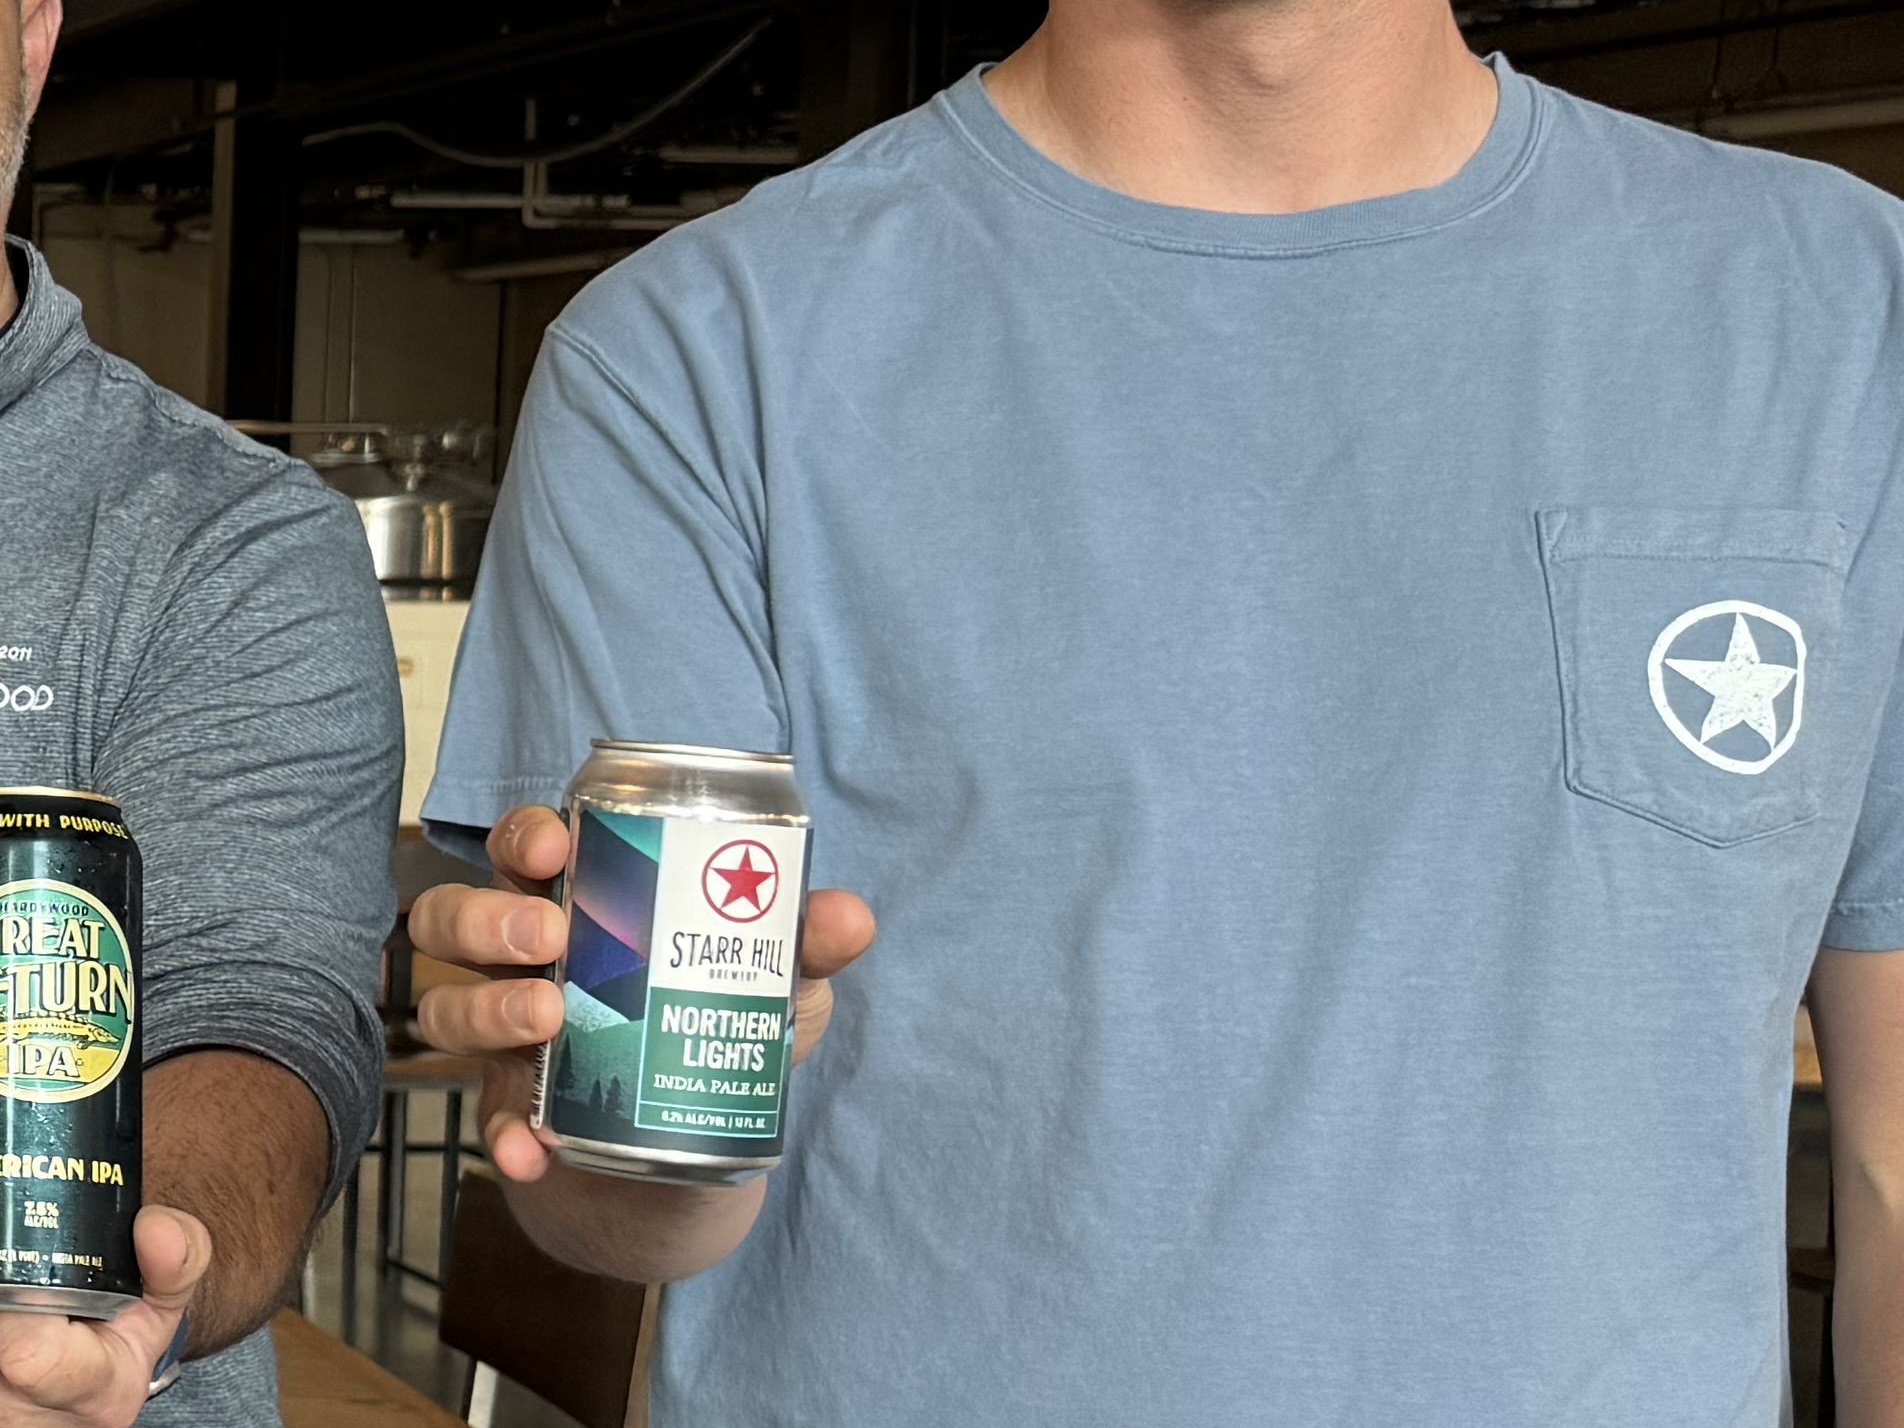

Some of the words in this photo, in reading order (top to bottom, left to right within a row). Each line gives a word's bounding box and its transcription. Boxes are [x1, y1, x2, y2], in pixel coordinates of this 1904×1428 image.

[59, 815, 129, 840] PURPOSE
[670, 931, 743, 968] STARR
[751, 938, 784, 977] HILL
[661, 1004, 781, 1040] NORTHERN
[7, 1044, 80, 1078] IPA
[682, 1037, 765, 1072] LIGHTS
[653, 1073, 706, 1093] INDIA
[710, 1079, 751, 1096] PALE
[751, 1082, 776, 1096] ALE
[91, 1160, 124, 1186] IPA
